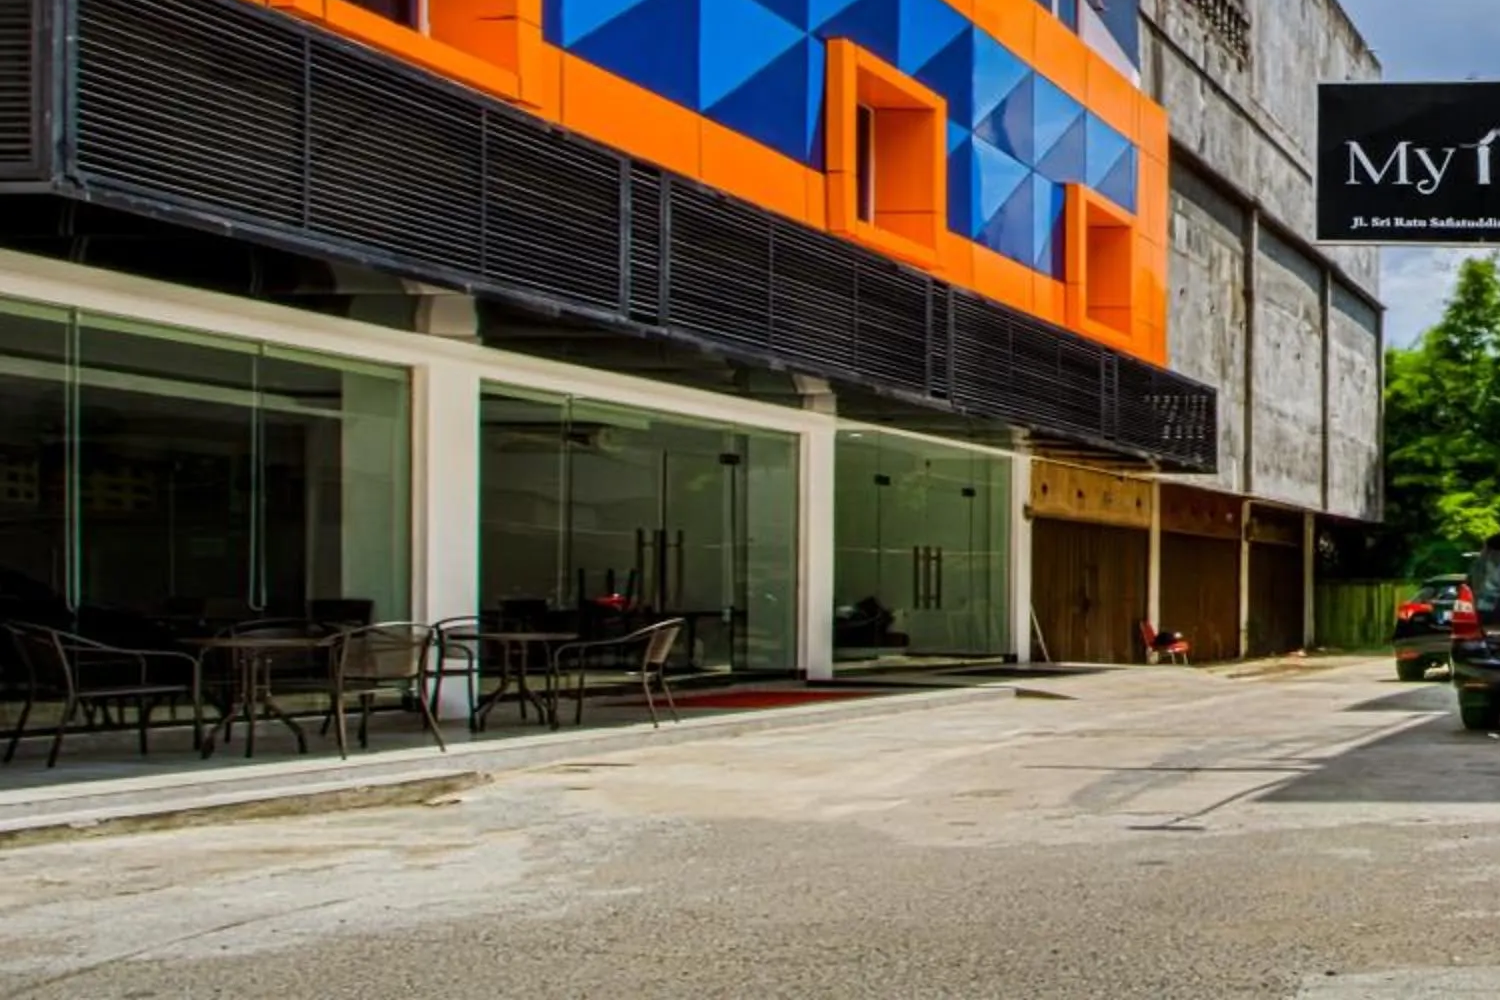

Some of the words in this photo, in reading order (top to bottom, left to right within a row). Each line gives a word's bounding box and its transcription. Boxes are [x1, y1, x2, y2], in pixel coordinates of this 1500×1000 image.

[1345, 140, 1456, 195] My
[1350, 216, 1369, 229] Jl.
[1371, 217, 1391, 227] Sri
[1393, 217, 1427, 228] Ratu
